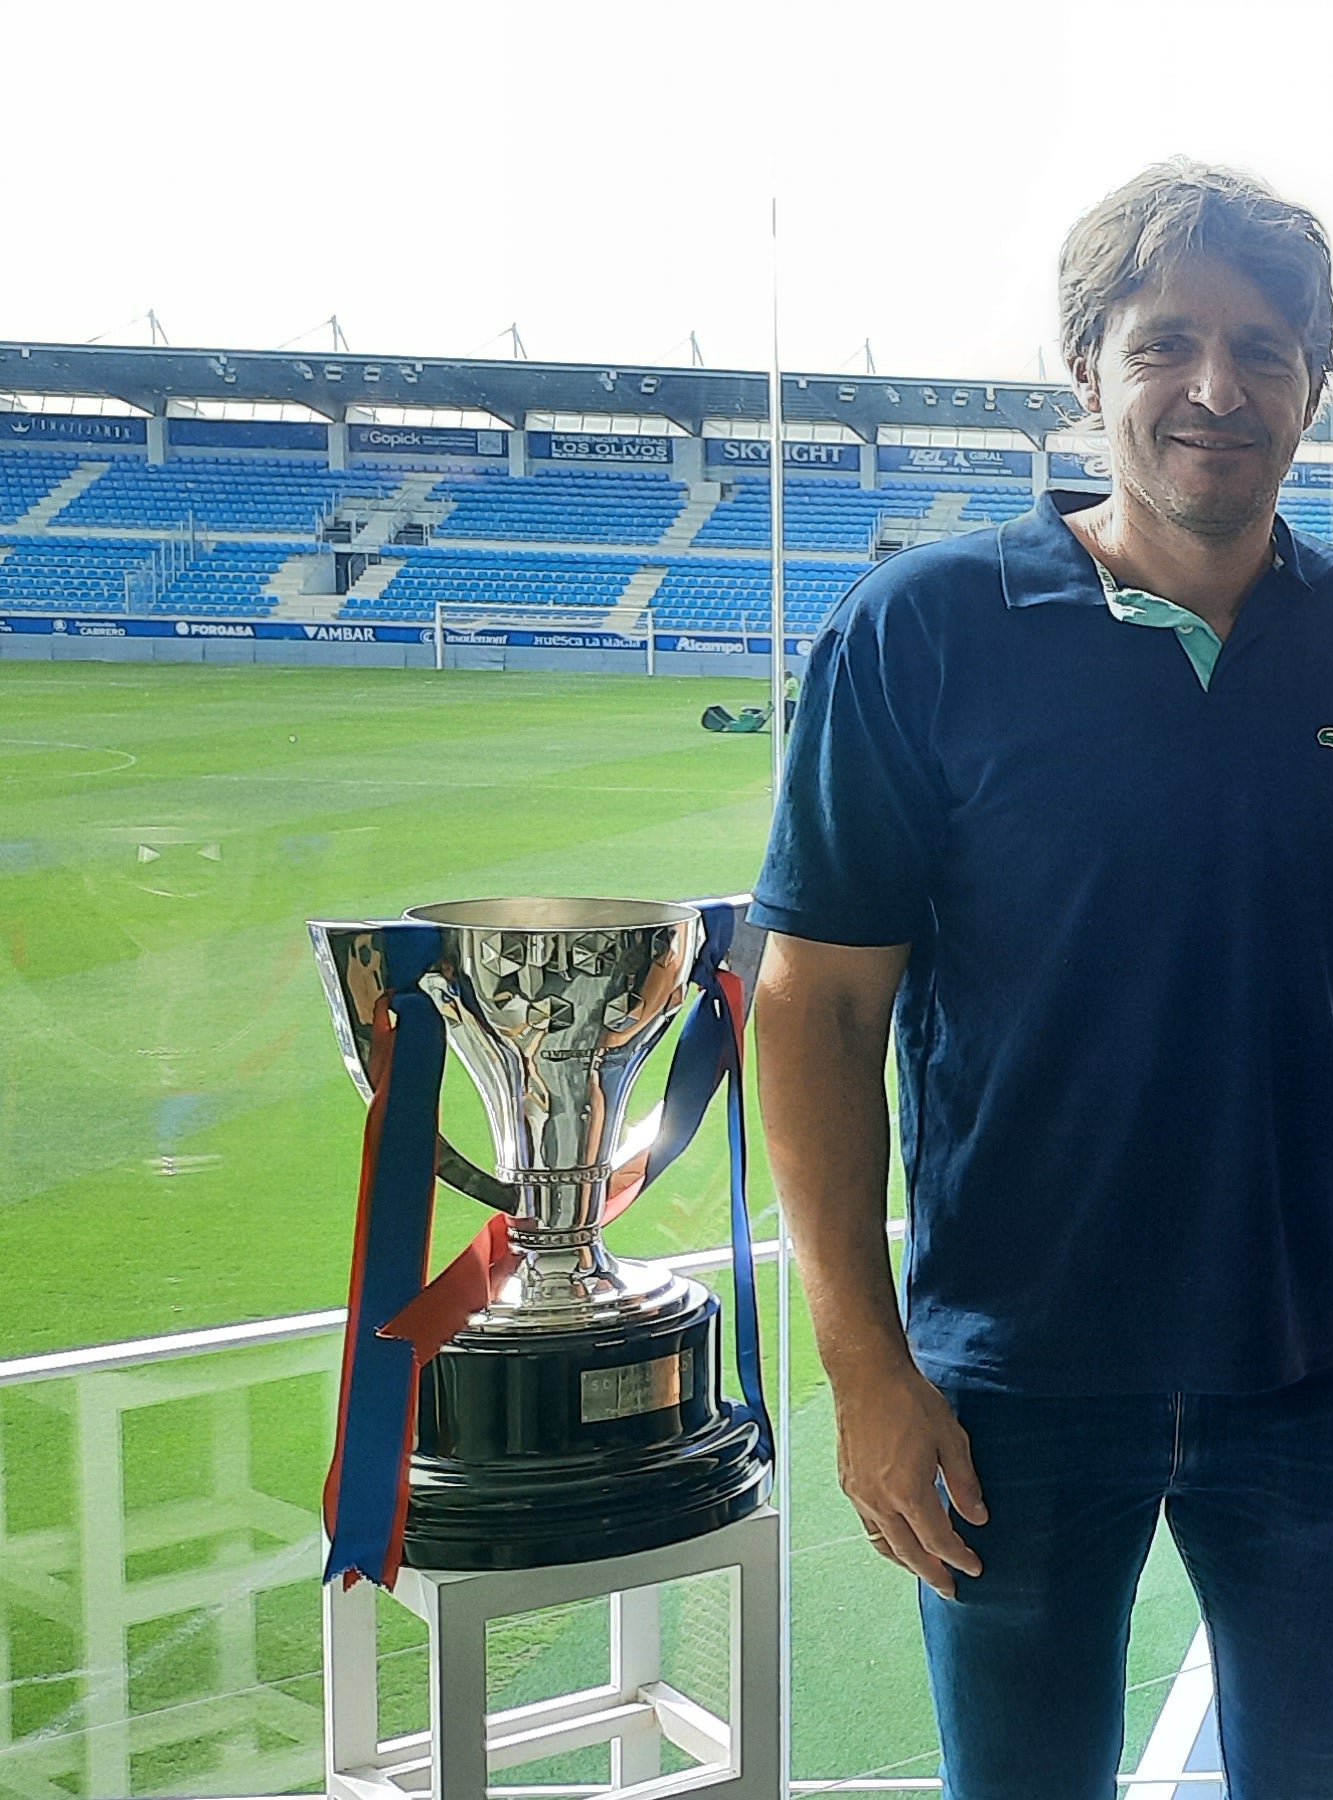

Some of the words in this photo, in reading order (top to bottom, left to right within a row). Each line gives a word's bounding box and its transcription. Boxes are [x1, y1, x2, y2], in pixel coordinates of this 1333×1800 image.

[369, 430, 421, 447] Gopick
[551, 442, 589, 454] LOS
[595, 443, 667, 456] OLIVOS
[723, 441, 844, 463] SKYIGHT
[191, 624, 254, 636] FORGASA
[316, 625, 376, 641] AMBAR
[676, 637, 744, 654] Alcampo
